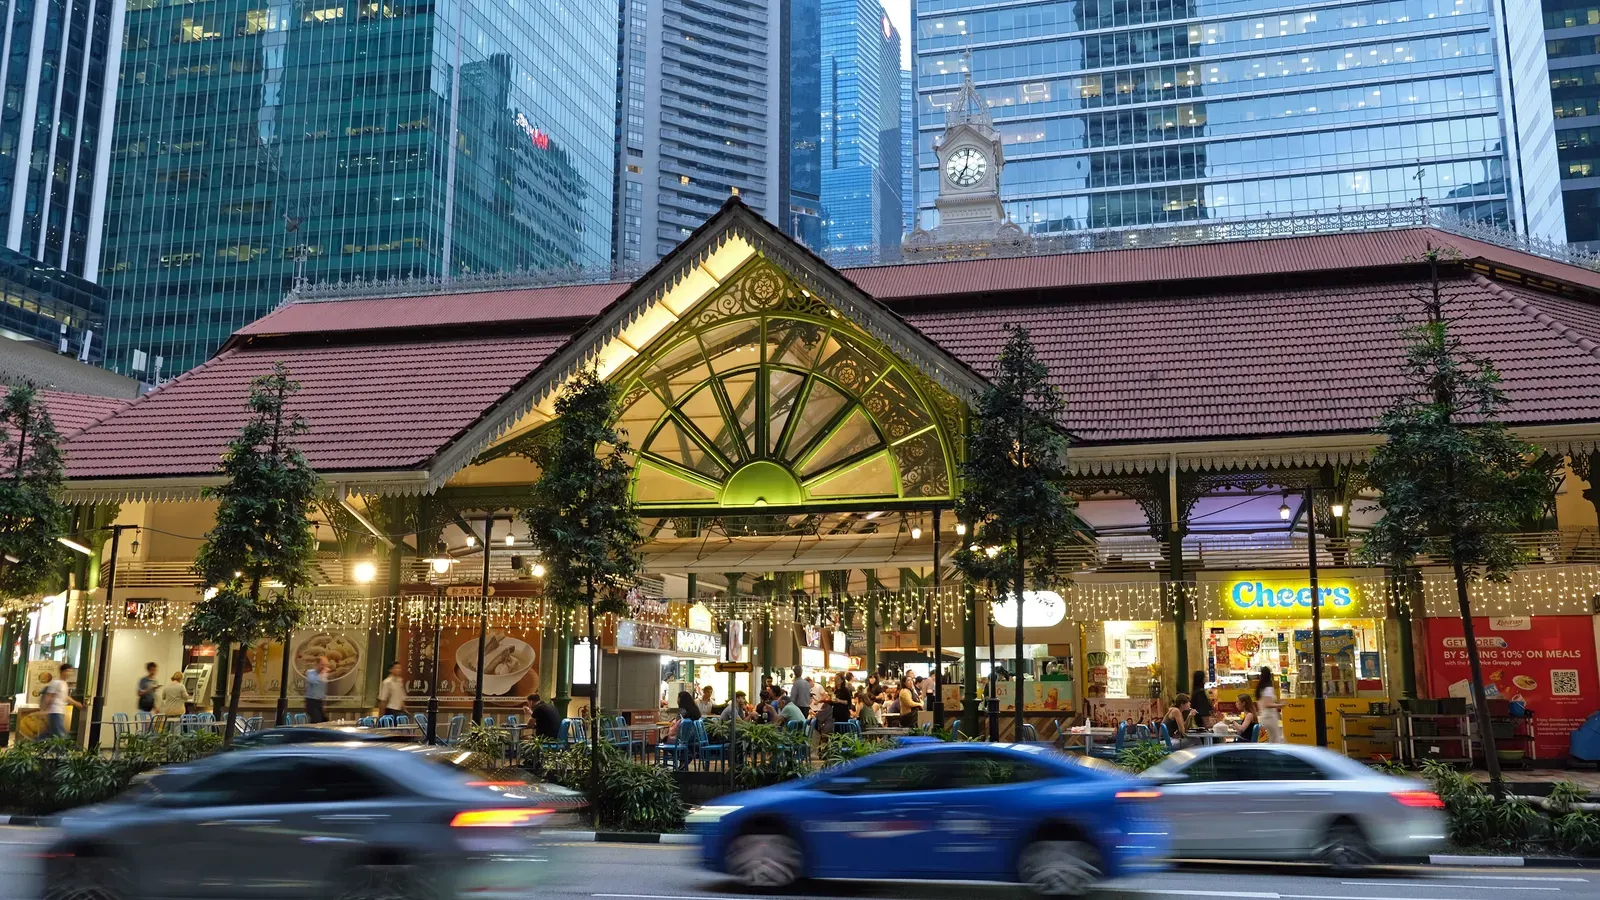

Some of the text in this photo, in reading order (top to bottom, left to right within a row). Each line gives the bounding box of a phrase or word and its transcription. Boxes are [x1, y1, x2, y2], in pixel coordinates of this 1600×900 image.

[1232, 581, 1351, 608] Cheers
[1444, 651, 1457, 659] BY
[1459, 650, 1498, 659] SING
[1526, 650, 1543, 658] ON
[1546, 650, 1581, 658] MEALS
